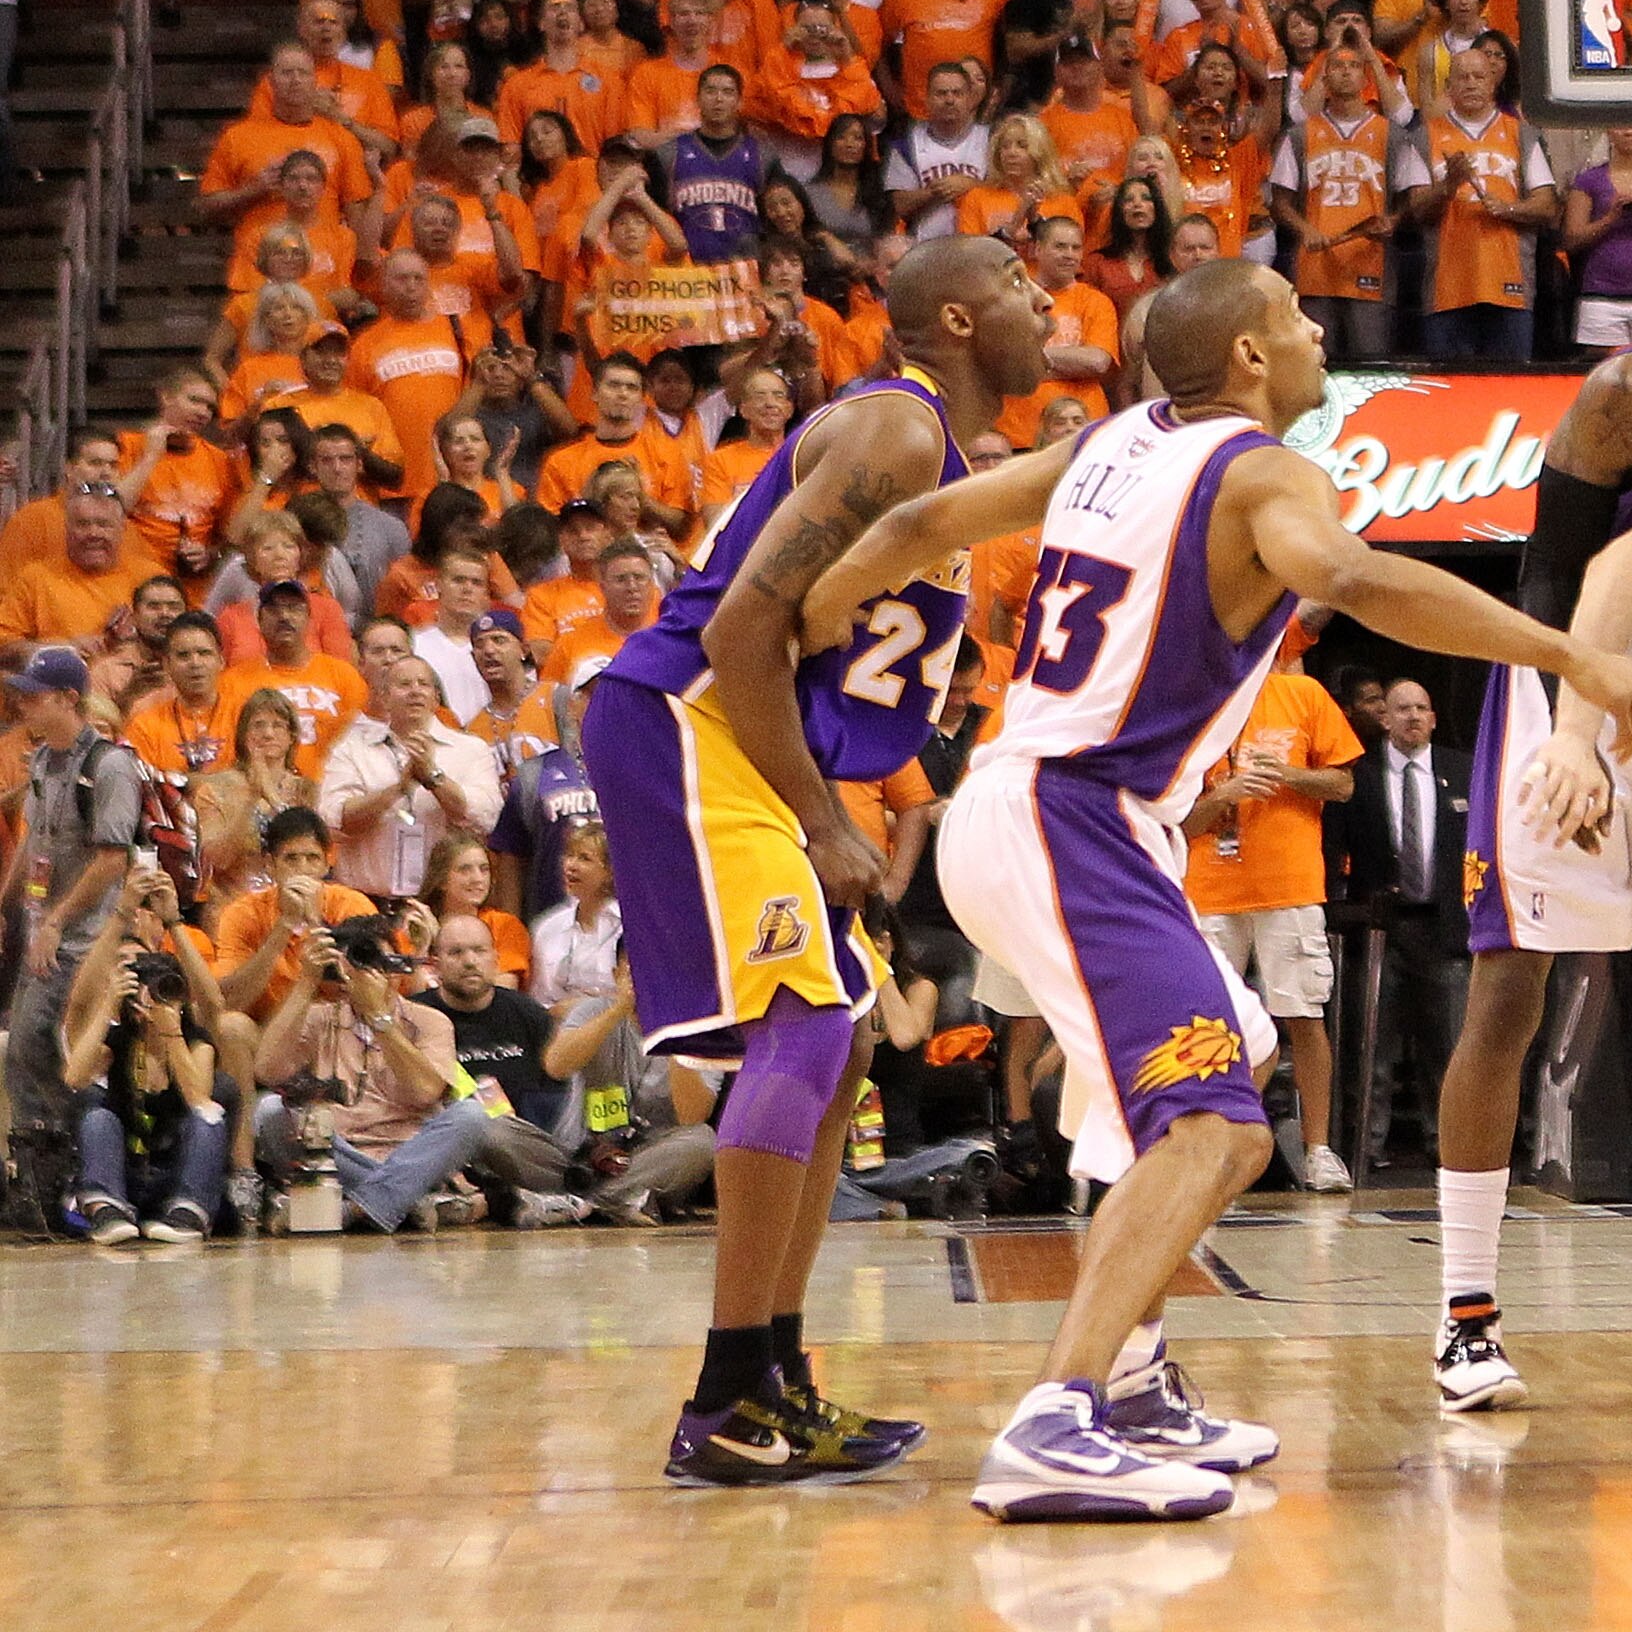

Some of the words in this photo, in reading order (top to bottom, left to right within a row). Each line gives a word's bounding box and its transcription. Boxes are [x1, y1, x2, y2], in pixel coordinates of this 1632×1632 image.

[1586, 51, 1611, 65] NBA
[1306, 150, 1386, 192] PHX
[1322, 180, 1361, 207] 23
[610, 278, 641, 300] GO
[649, 276, 745, 300] PHOENIX
[610, 313, 673, 334] SUNS
[842, 598, 966, 726] 24
